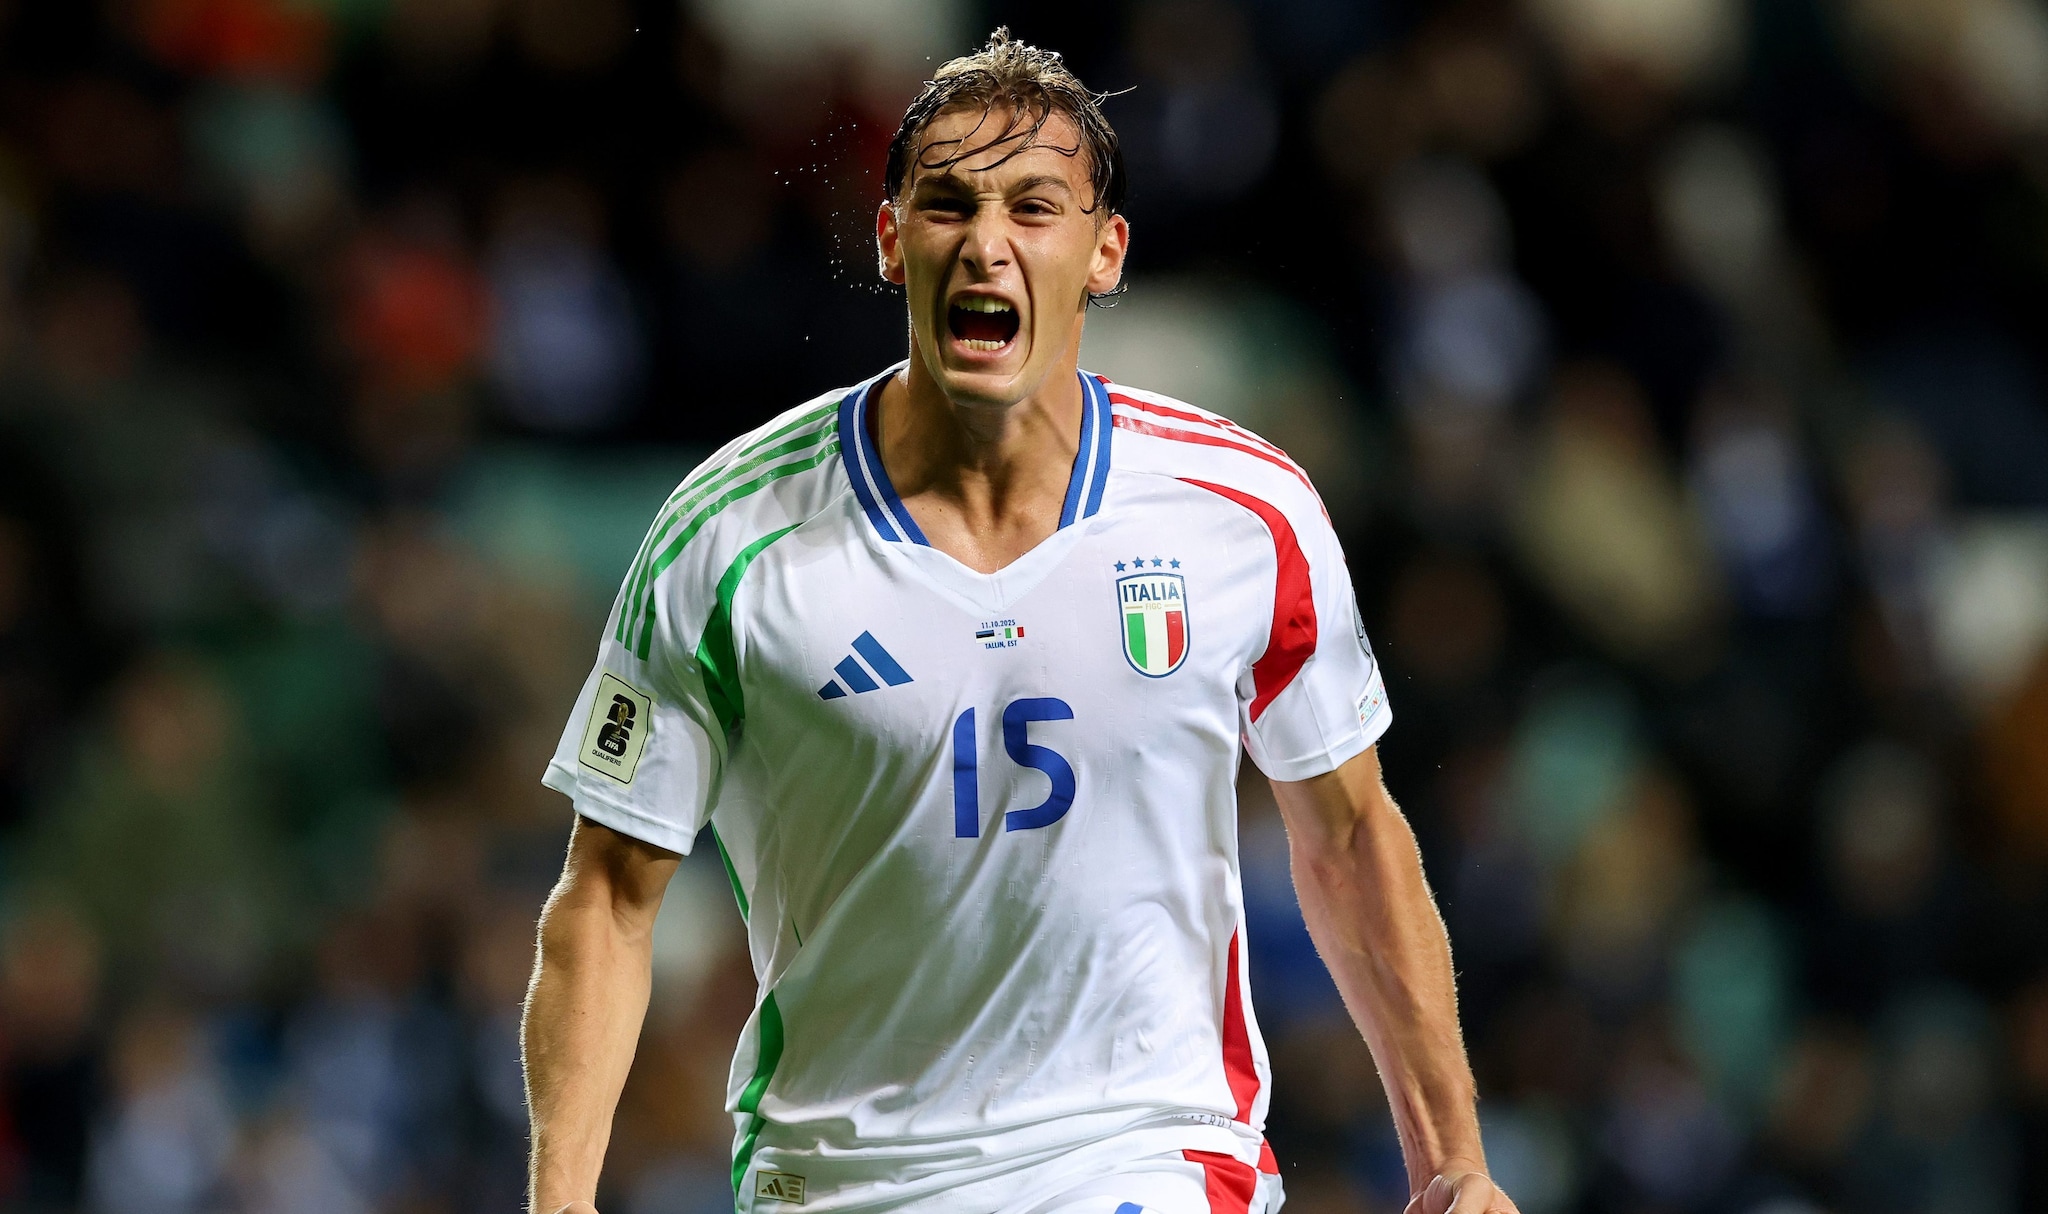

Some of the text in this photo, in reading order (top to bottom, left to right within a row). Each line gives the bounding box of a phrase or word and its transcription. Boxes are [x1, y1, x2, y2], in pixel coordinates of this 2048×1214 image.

[1123, 582, 1180, 602] ITALIA
[1145, 602, 1162, 610] FIGC
[981, 619, 1016, 629] 11.10.2025
[1007, 640, 1018, 648] EST
[604, 739, 620, 752] FIFA
[591, 748, 622, 767] QUALIFIERS
[953, 697, 1076, 838] 15
